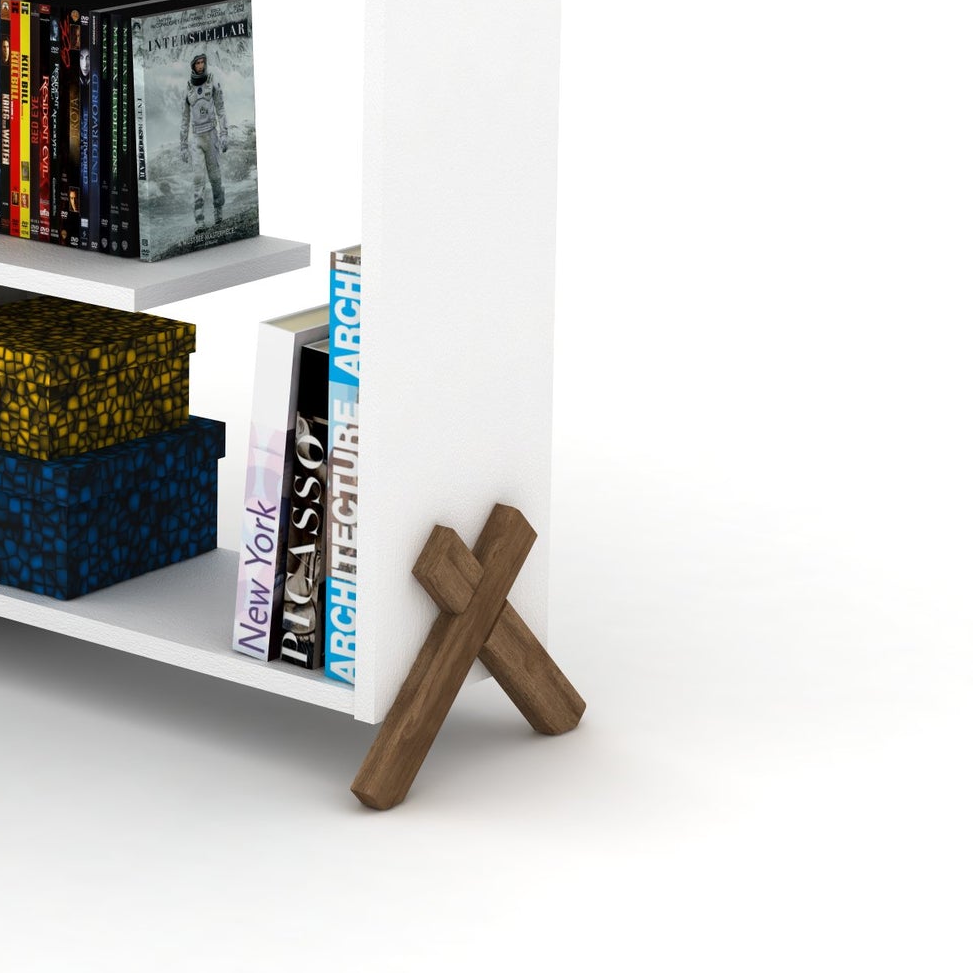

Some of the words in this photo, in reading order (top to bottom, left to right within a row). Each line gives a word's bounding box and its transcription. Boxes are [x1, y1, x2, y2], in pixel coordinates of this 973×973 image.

[148, 22, 246, 52] INTERSTELLAR
[10, 51, 19, 74] KILL
[21, 54, 29, 79] KILL
[10, 75, 19, 100] BILL
[21, 80, 29, 104] BILL
[31, 95, 39, 117] EYE
[39, 75, 49, 141] RESIDENT
[31, 120, 39, 144] RED
[91, 73, 99, 183] UNDERWORLD
[2, 129, 10, 165] WELTEN
[41, 145, 49, 179] EVIL
[244, 500, 277, 566] York
[330, 399, 359, 686] ARCHITECTURE
[281, 434, 325, 668] PICASSO
[238, 577, 271, 654] New
